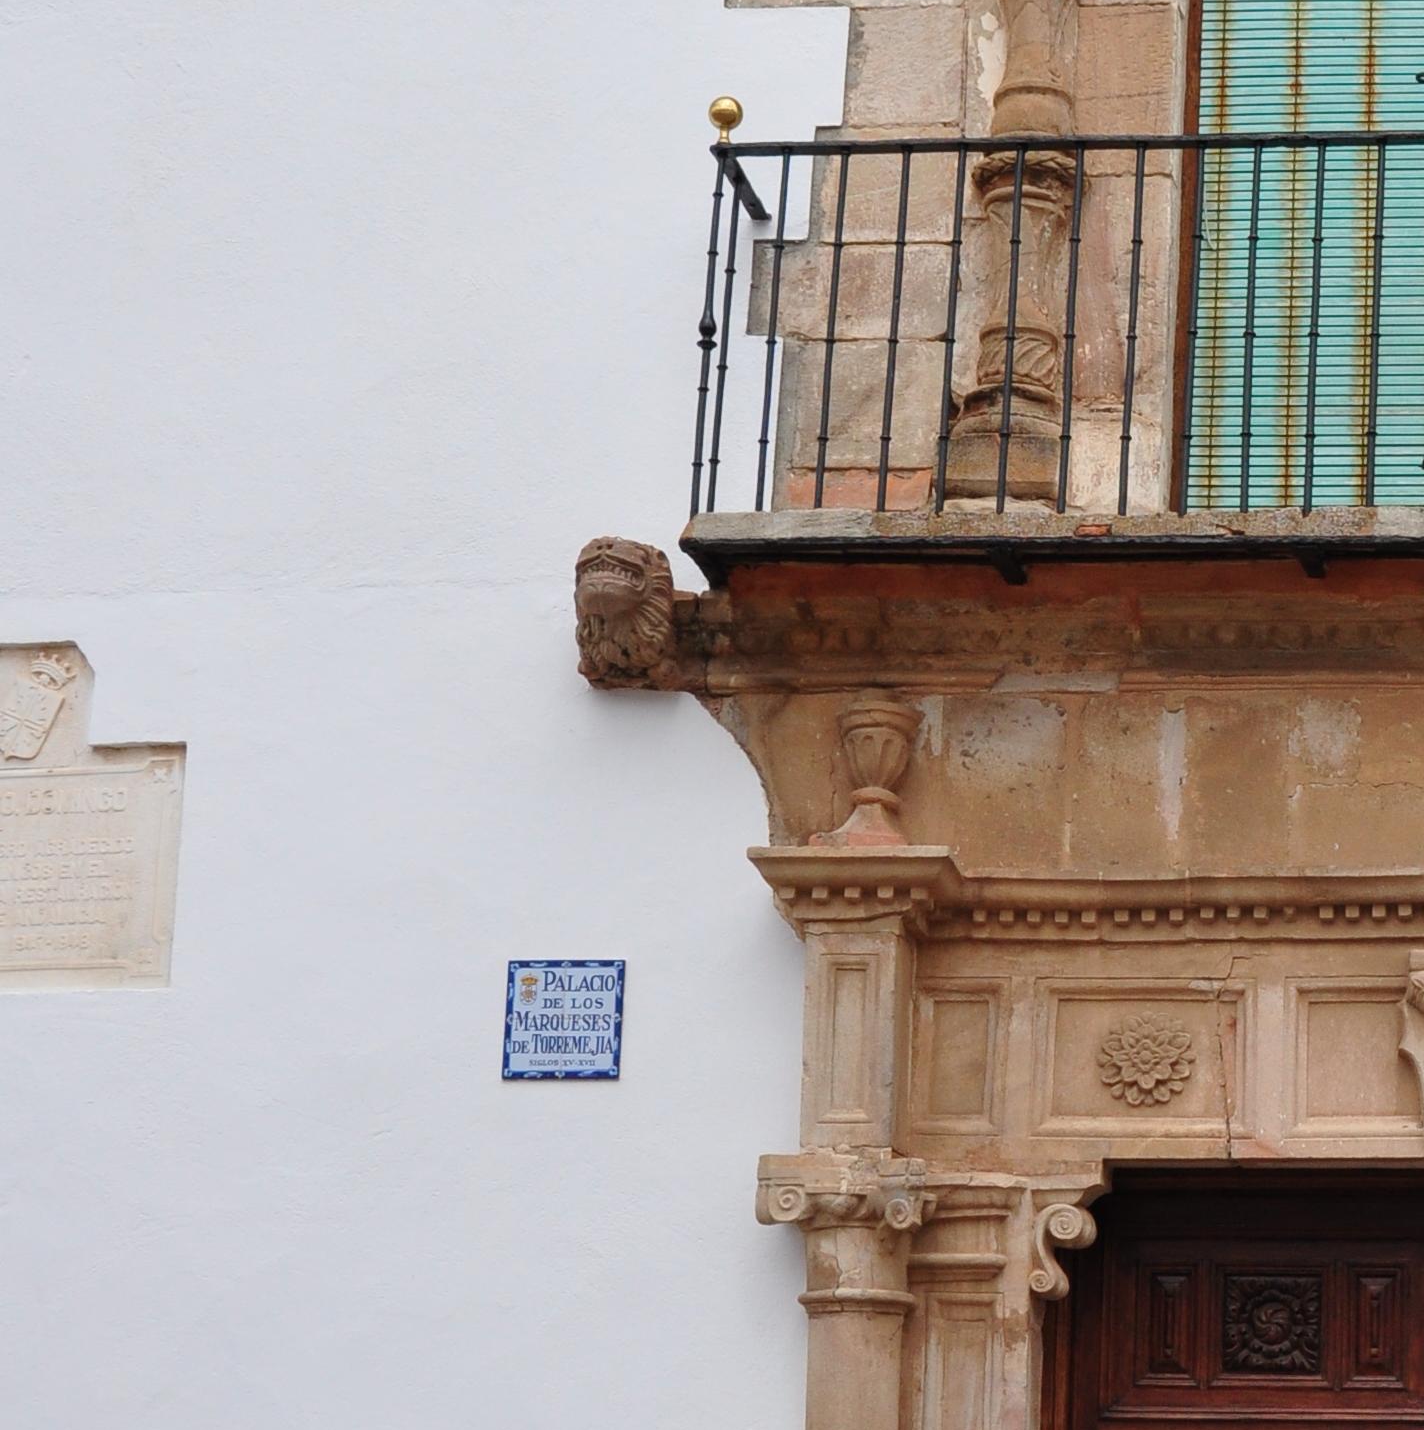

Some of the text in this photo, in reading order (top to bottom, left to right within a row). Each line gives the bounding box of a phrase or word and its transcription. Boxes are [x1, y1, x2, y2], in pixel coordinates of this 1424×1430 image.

[542, 970, 616, 992] PALACIO
[542, 997, 604, 1010] DE LOS
[514, 1011, 612, 1032] MARQUESES
[511, 1034, 613, 1056] DE TORREMEJIA
